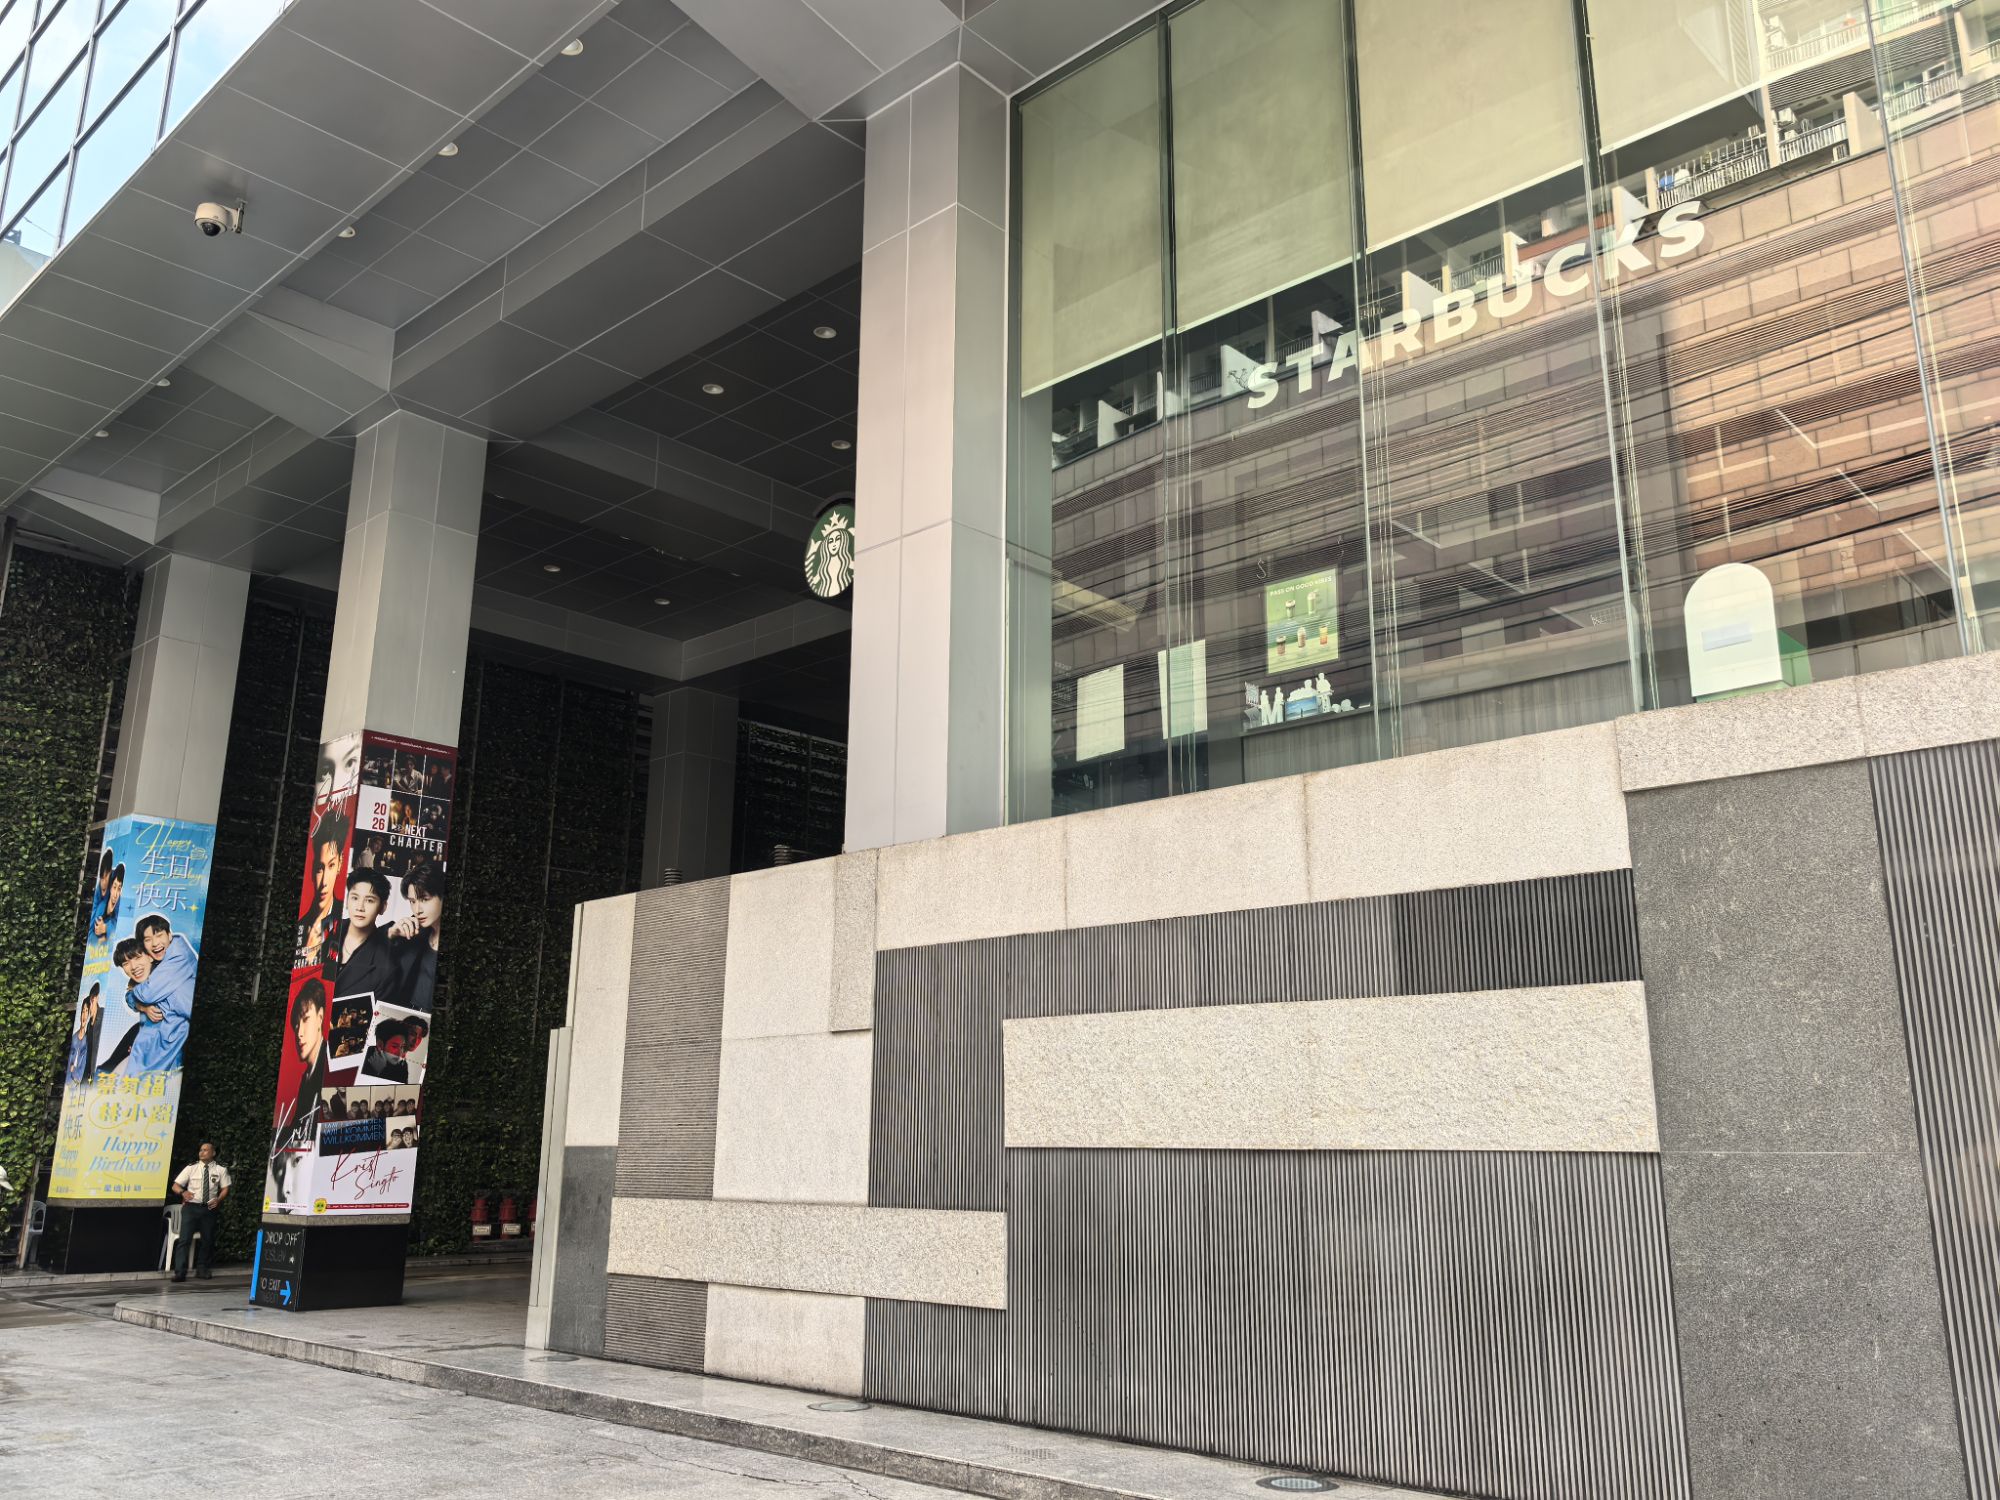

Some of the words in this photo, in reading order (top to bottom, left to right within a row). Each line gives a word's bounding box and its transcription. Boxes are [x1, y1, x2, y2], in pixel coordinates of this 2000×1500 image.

[1247, 201, 1706, 409] STARBUCKS
[1270, 588, 1284, 596] PASS
[1296, 580, 1313, 590] GOOD
[374, 802, 387, 816] 20
[372, 817, 386, 831] 26
[404, 824, 428, 838] NEXT
[389, 834, 444, 854] CHAPTER
[139, 850, 190, 879] 生日
[136, 881, 187, 911] 快乐
[270, 1092, 321, 1170] Krist
[322, 1132, 385, 1145] WILLKOMMEN
[102, 1136, 159, 1155] Happy
[330, 1145, 389, 1191] Krist
[354, 1166, 404, 1200] Singto
[265, 1231, 283, 1245] DROP
[284, 1231, 298, 1246] OFF
